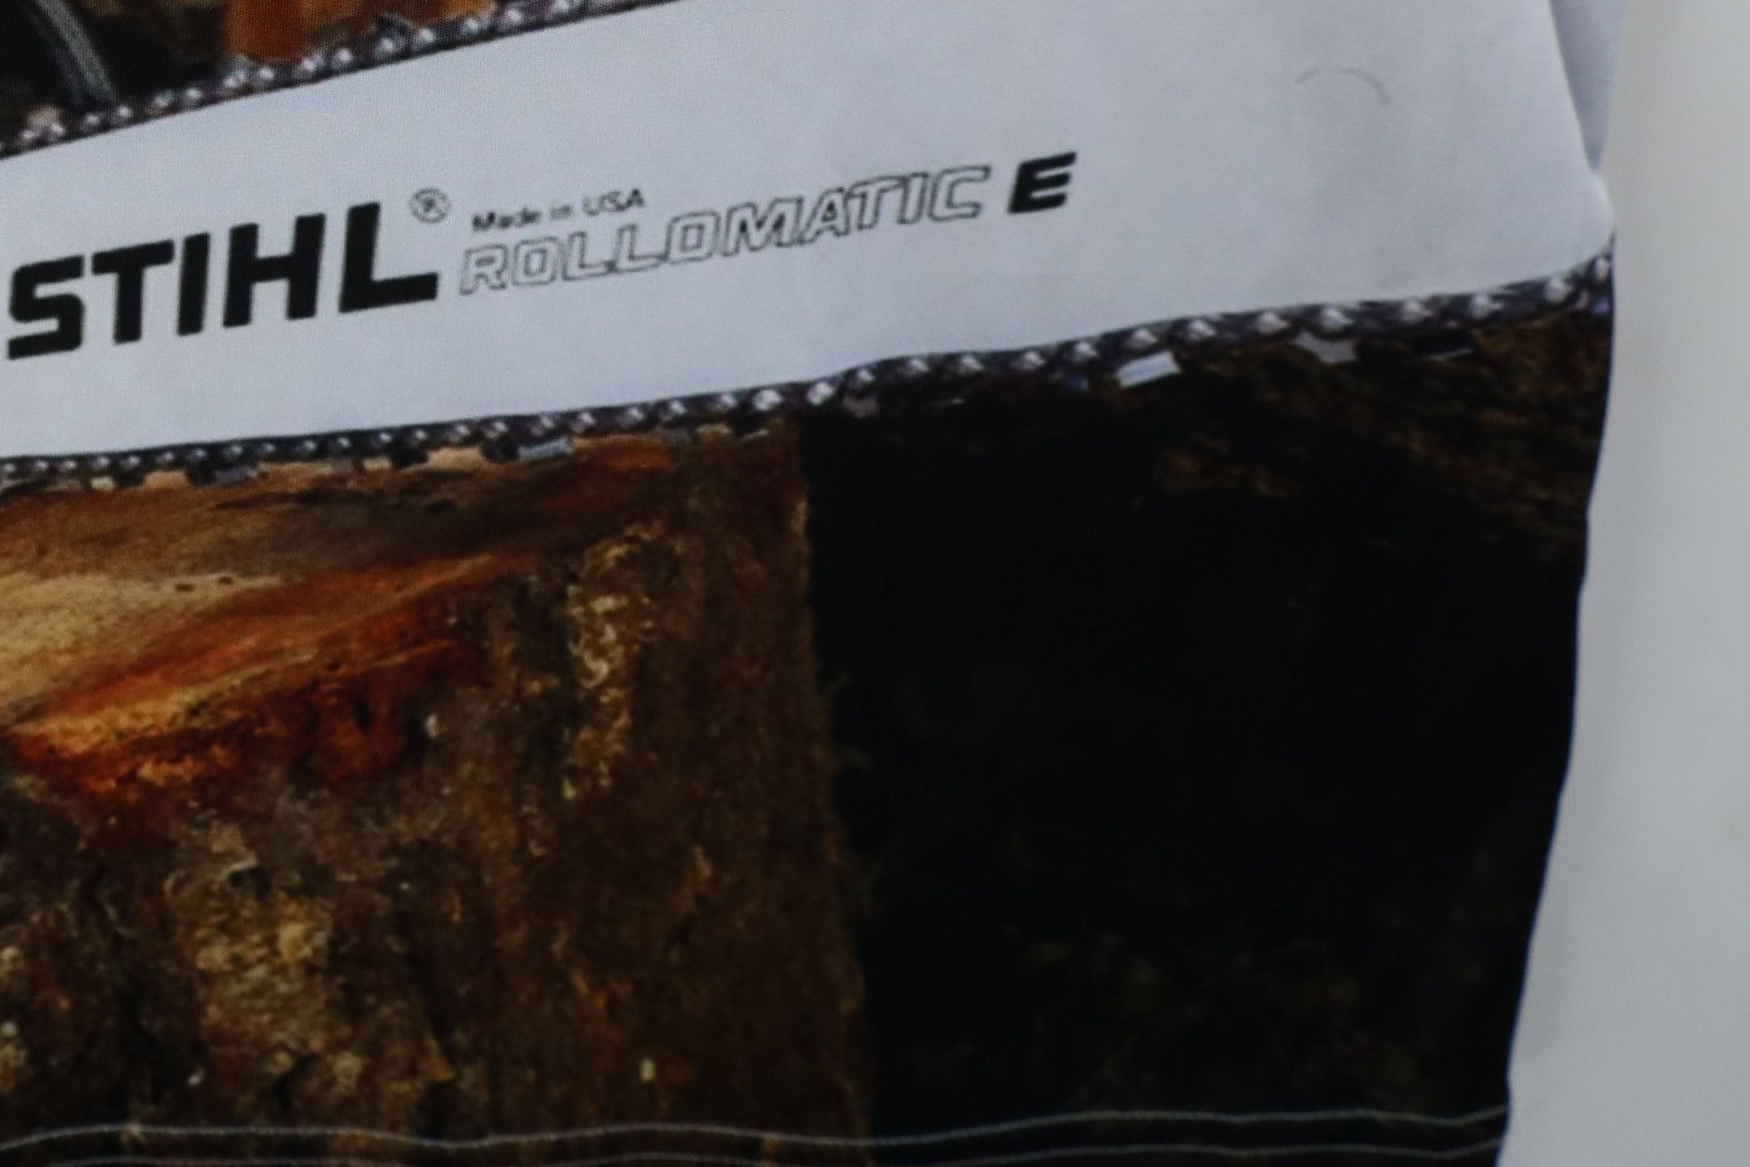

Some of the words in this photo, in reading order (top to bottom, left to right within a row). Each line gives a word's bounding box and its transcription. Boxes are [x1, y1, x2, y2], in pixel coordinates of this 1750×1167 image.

[458, 165, 991, 295] ROLLOMATIC
[1007, 152, 1076, 215] E
[580, 187, 645, 217] USA
